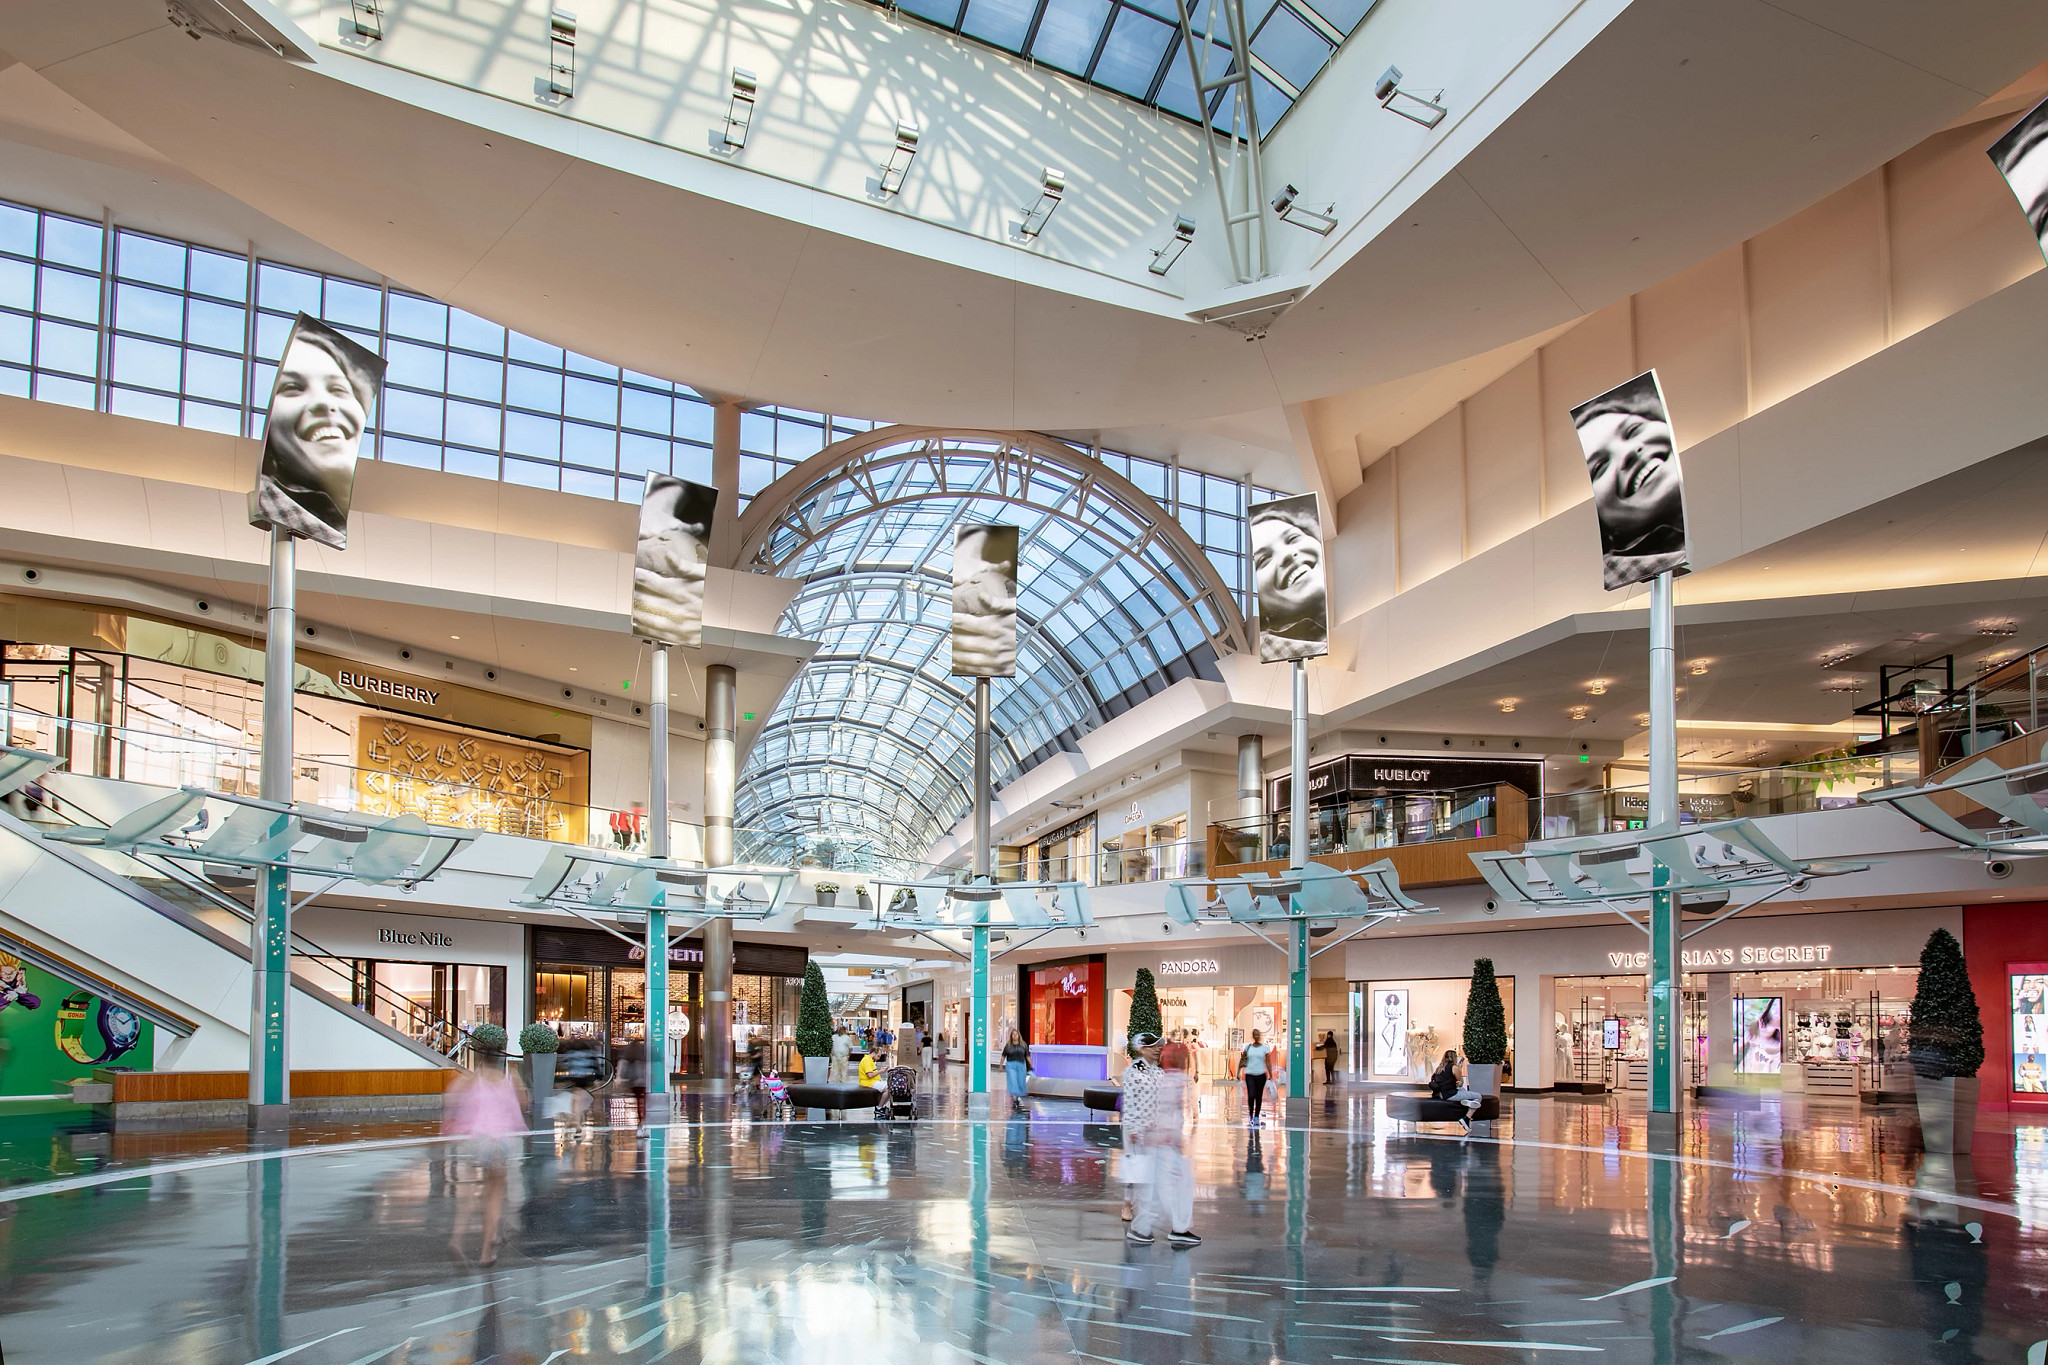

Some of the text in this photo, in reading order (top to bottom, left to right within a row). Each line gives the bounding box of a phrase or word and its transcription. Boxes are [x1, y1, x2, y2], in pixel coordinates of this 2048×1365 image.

[339, 670, 439, 705] BURBERRY
[1374, 769, 1430, 781] HUBLOT
[378, 928, 453, 947] Blue Nile
[1609, 946, 1831, 968] VICRIA'S SECRET
[1161, 961, 1217, 974] PANDORA
